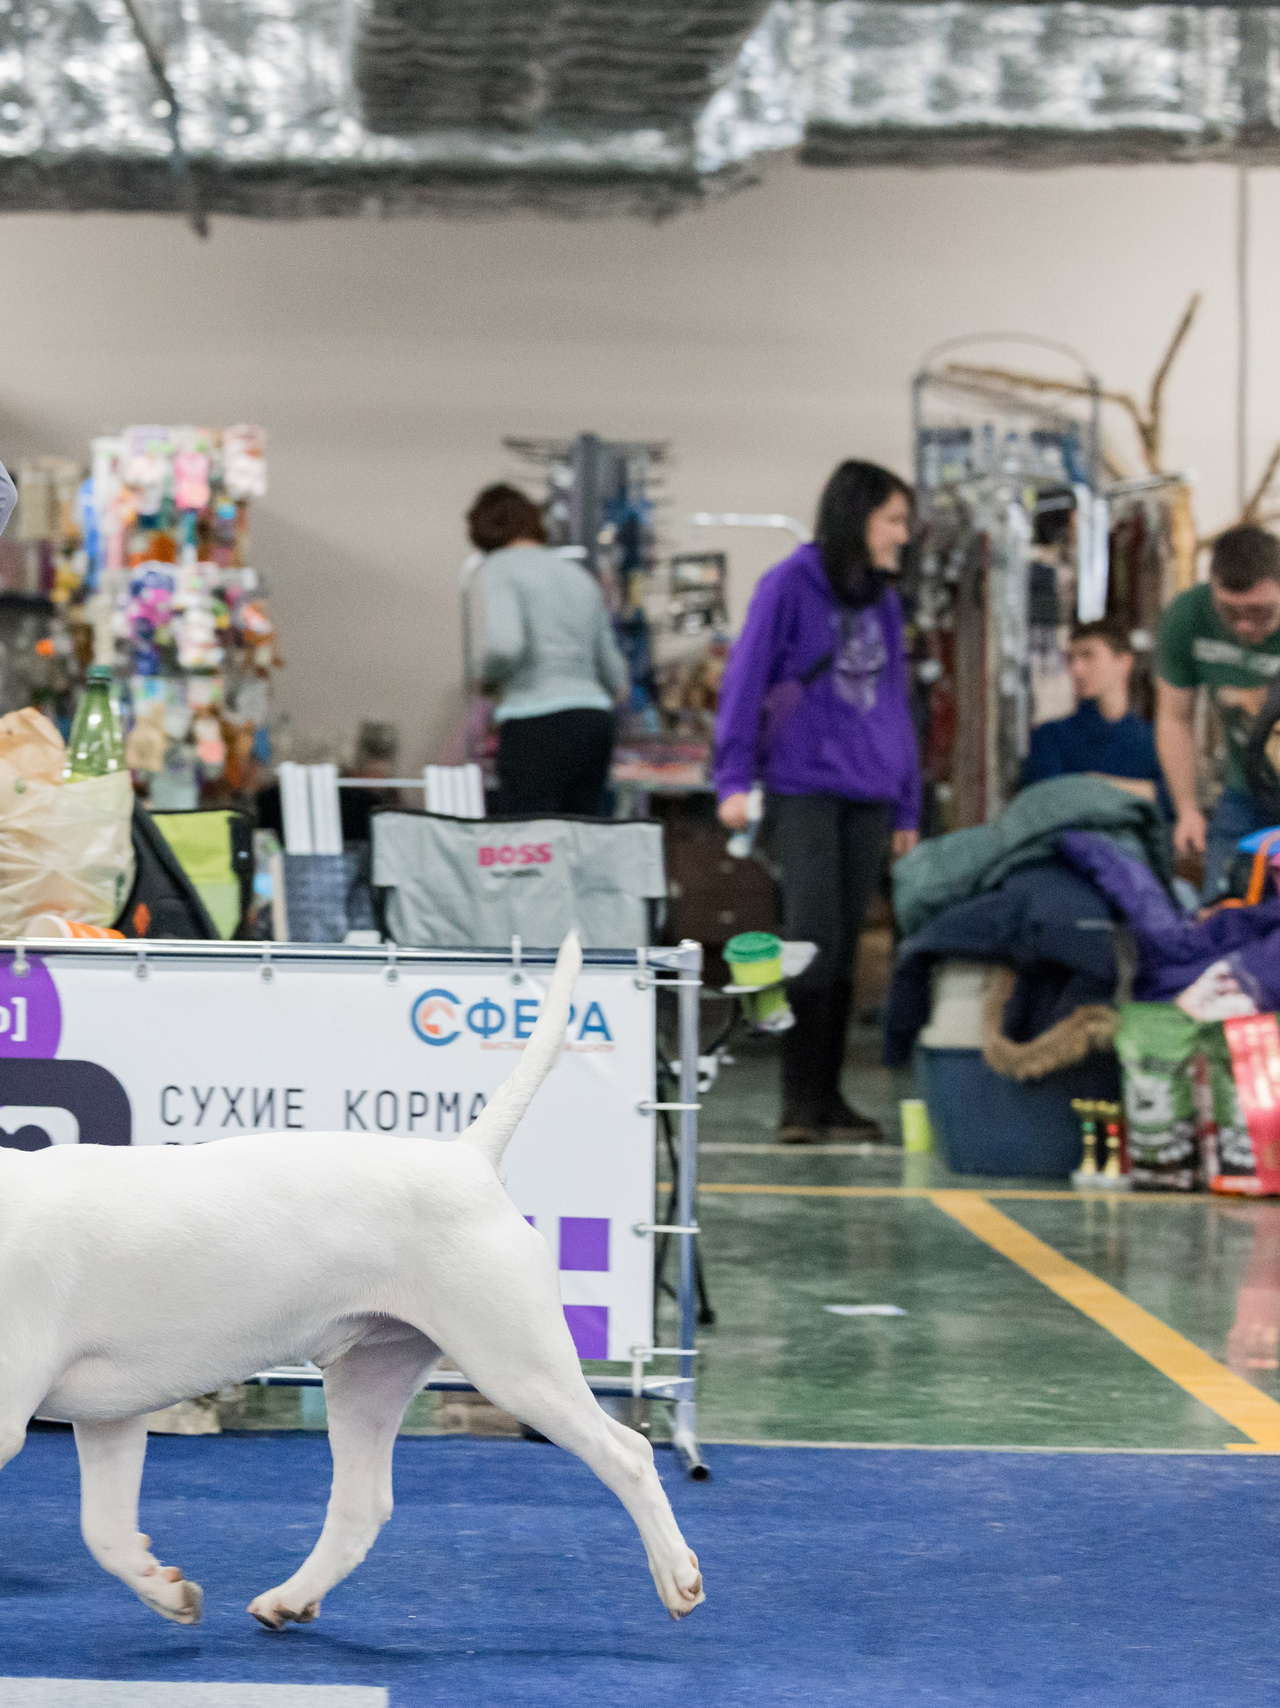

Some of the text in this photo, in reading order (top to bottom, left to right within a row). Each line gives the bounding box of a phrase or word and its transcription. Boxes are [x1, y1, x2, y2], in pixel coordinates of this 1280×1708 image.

[477, 844, 553, 867] BOSS
[411, 989, 614, 1046] СФЕА
[160, 1085, 305, 1129] СУХИЕ
